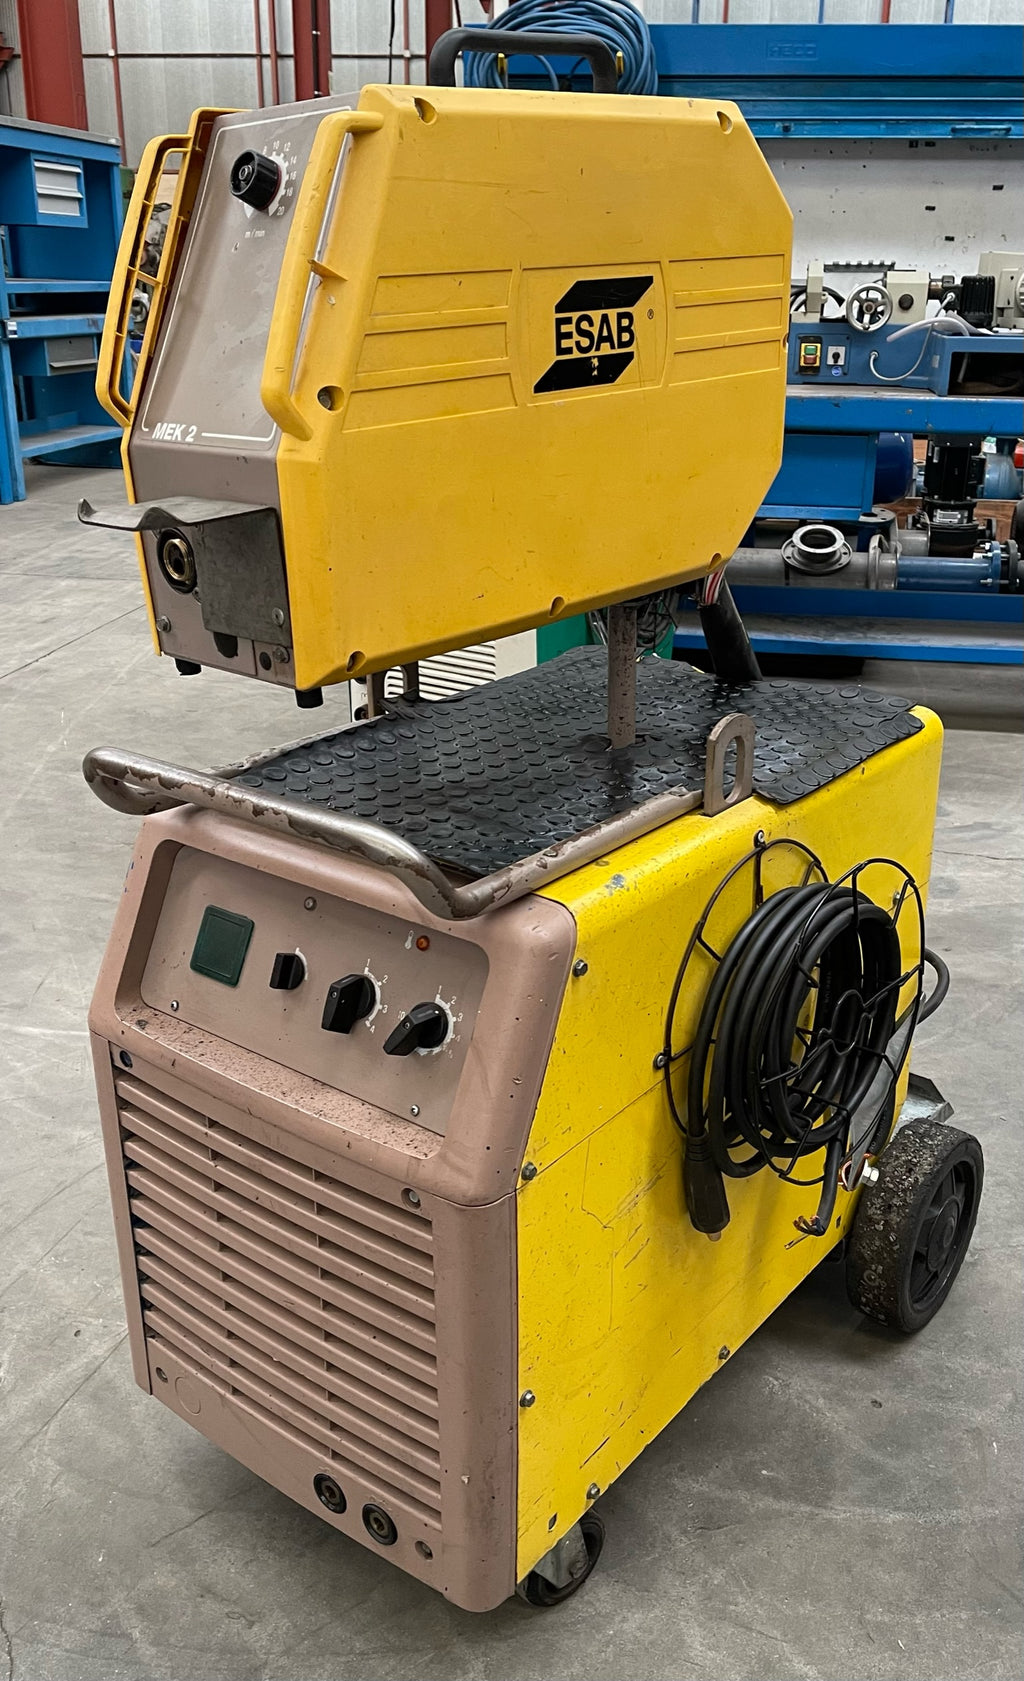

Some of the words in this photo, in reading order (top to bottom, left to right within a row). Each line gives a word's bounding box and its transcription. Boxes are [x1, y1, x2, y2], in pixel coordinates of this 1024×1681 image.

[284, 142, 291, 151] 12
[290, 156, 297, 164] 14
[290, 171, 297, 180] 16
[277, 206, 284, 215] 20
[555, 311, 635, 356] ESAB
[152, 423, 187, 440] MEK
[185, 425, 197, 442] 2
[383, 975, 388, 983] 2
[451, 996, 456, 1004] 2
[382, 1005, 388, 1013] 3
[458, 1013, 463, 1021] 3
[370, 1025, 375, 1033] 4
